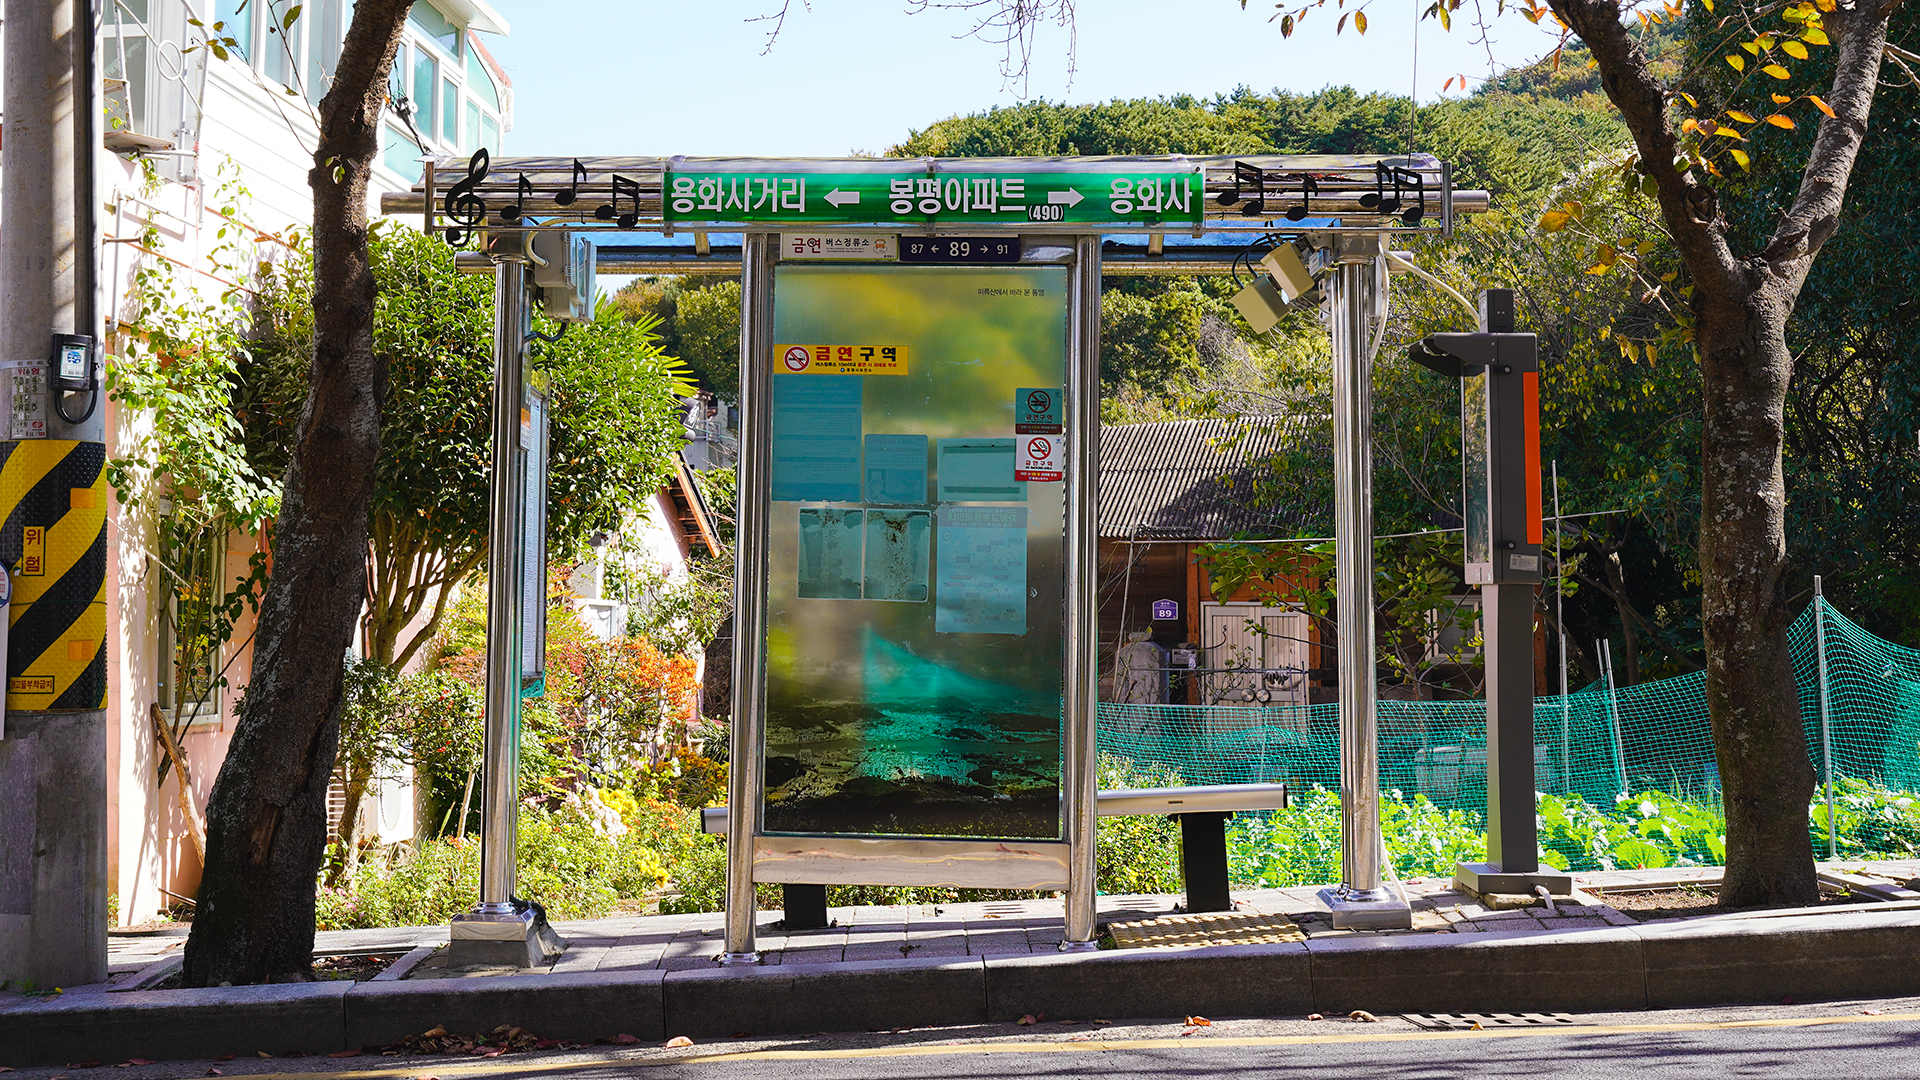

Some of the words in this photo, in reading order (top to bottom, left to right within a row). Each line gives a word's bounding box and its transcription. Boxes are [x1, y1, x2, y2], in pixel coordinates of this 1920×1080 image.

[671, 177, 805, 213] 용화사거리
[889, 178, 1026, 214] 봉평아파트
[1109, 178, 1192, 214] 용화사
[1028, 205, 1064, 220] (490)
[792, 237, 821, 254] 금연
[826, 238, 870, 247] 버스정류소
[911, 243, 924, 254] 87
[949, 241, 970, 257] 89
[997, 244, 1008, 254] 91
[816, 346, 897, 362] 금연구역
[25, 529, 40, 572] 위험
